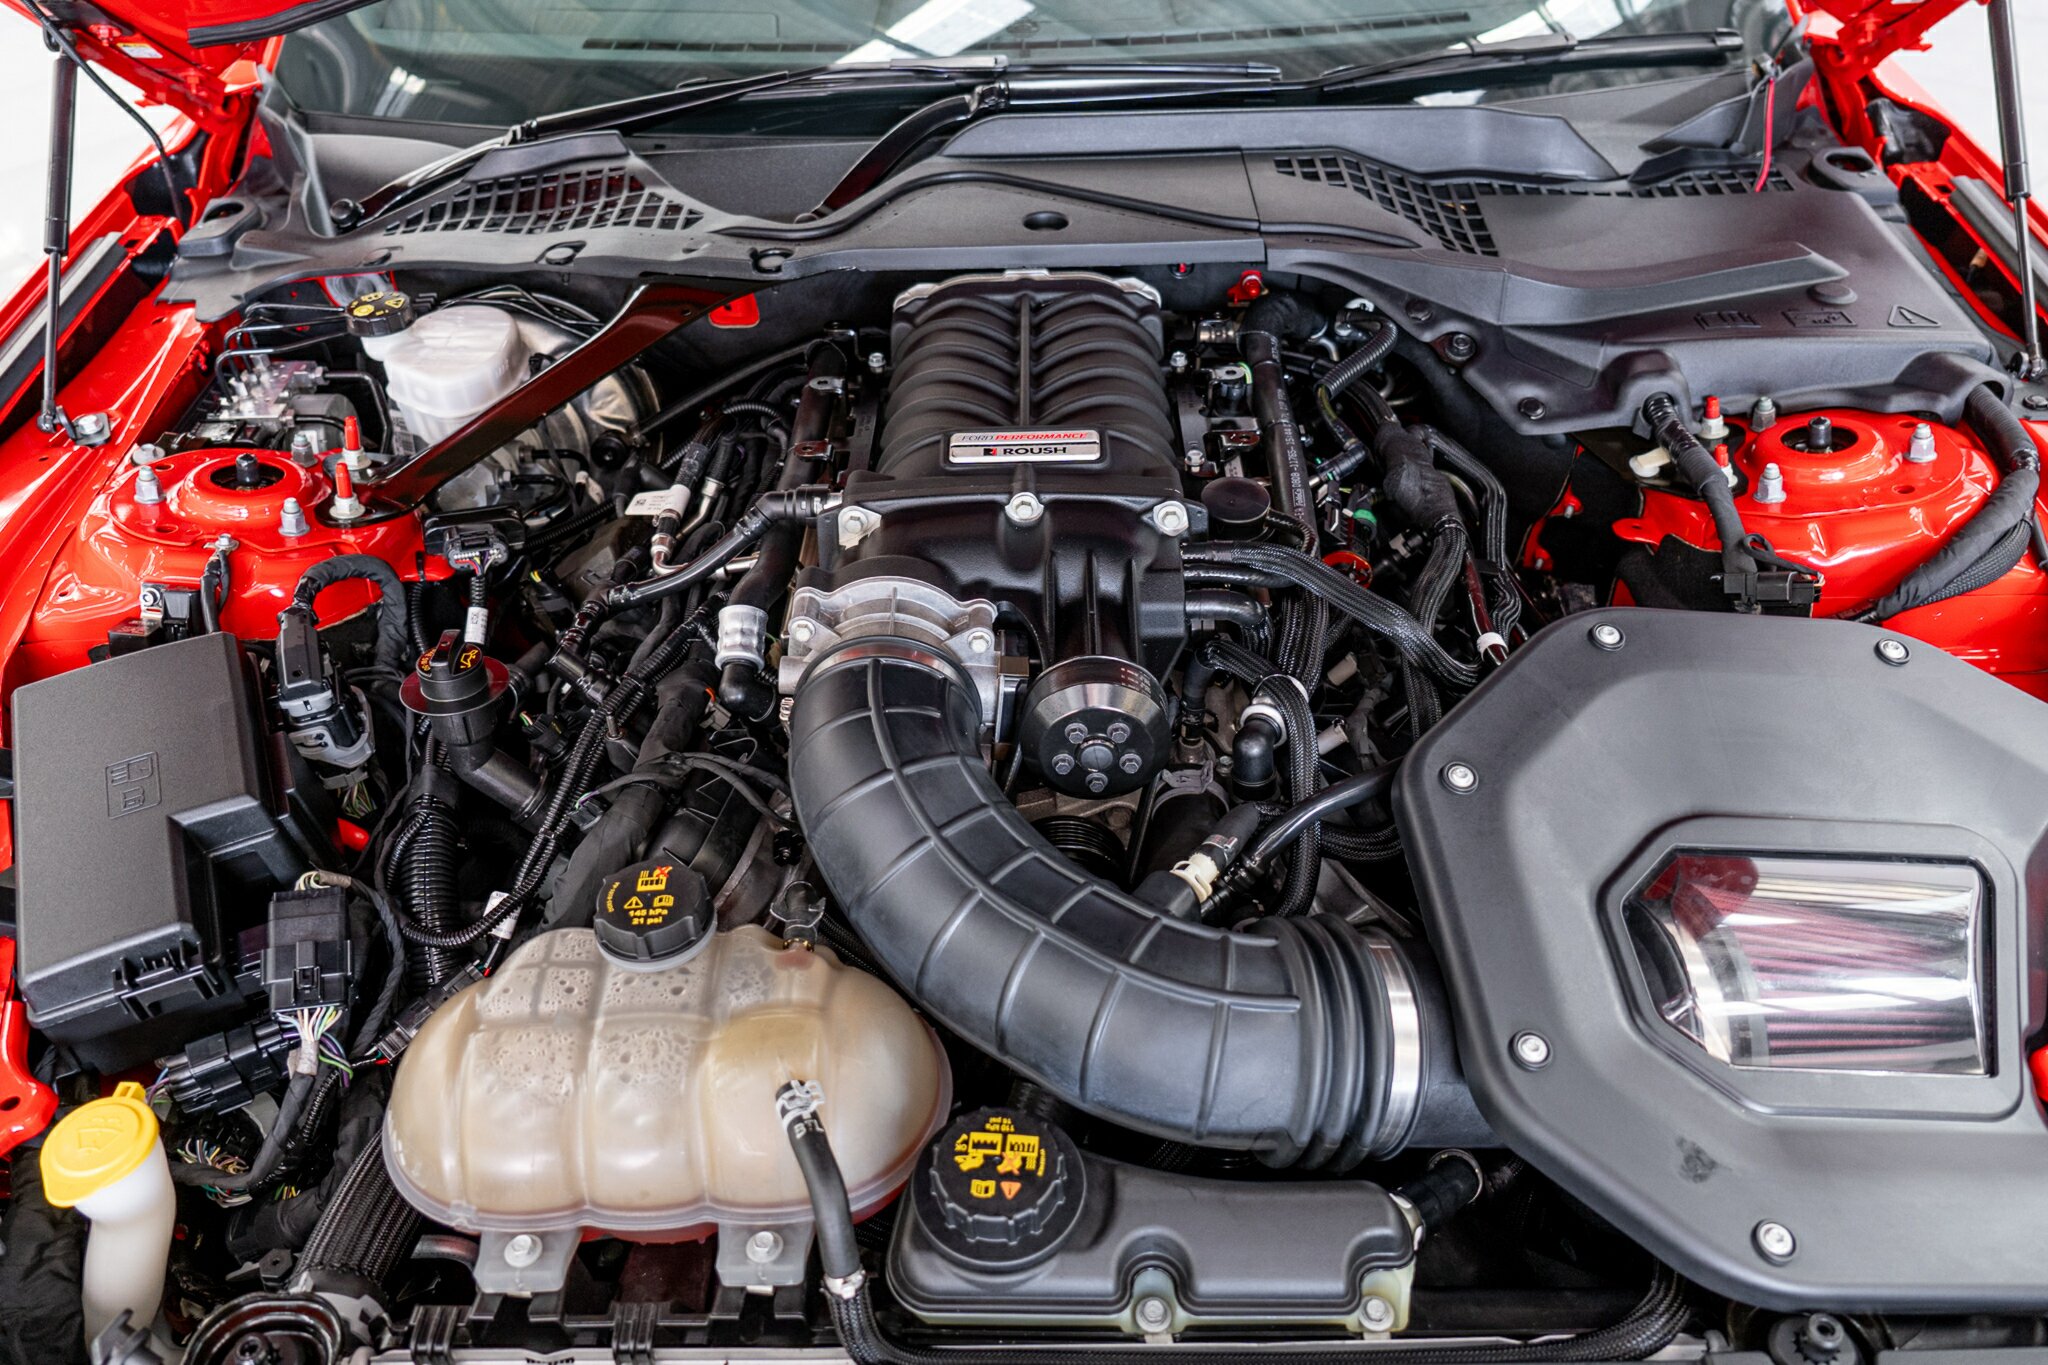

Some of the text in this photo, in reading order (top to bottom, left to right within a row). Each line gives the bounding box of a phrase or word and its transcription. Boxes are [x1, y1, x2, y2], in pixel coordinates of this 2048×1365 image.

[995, 432, 1089, 441] PERFORMANCE
[1003, 446, 1068, 456] ROUSH
[629, 908, 668, 917] 145 kPa
[632, 916, 663, 925] 21 psi
[954, 1143, 968, 1152] OK
